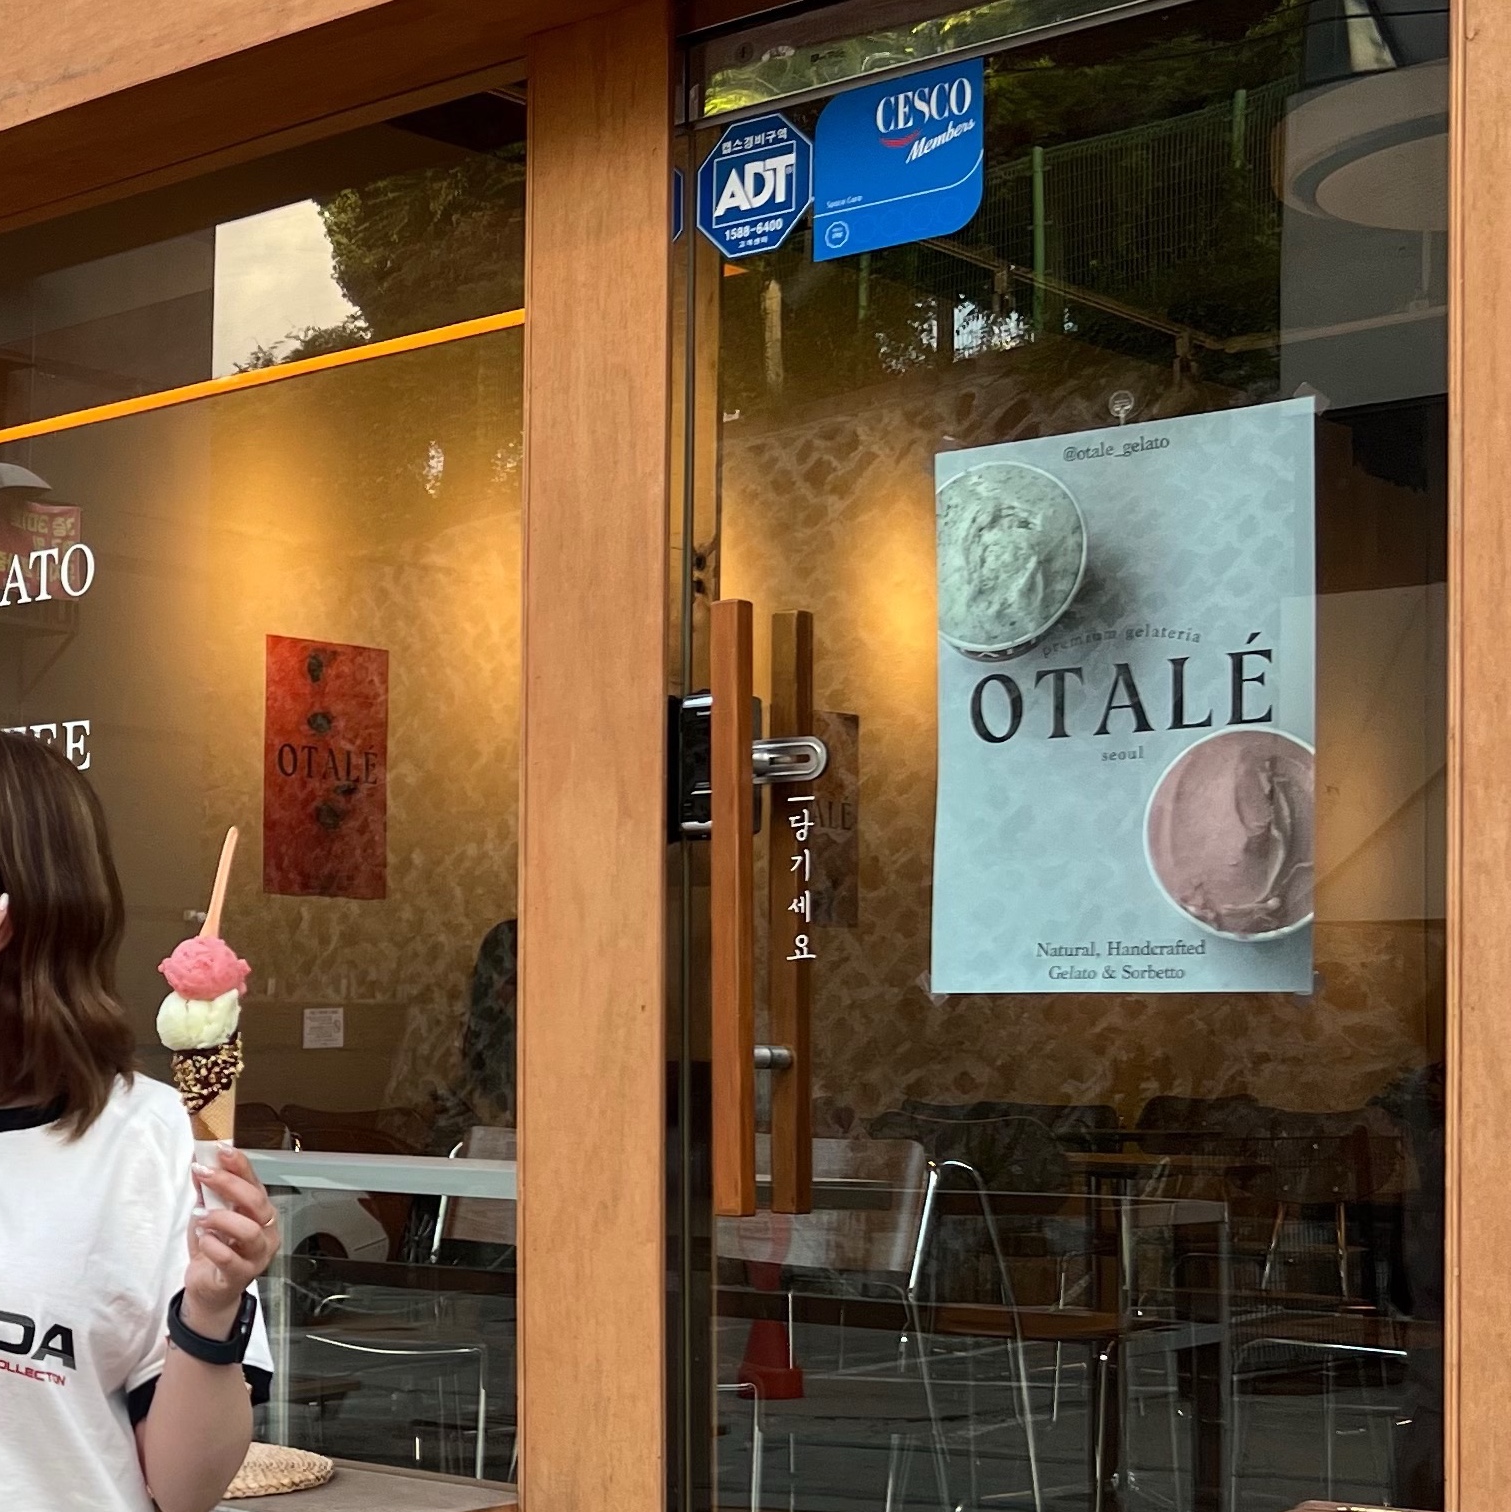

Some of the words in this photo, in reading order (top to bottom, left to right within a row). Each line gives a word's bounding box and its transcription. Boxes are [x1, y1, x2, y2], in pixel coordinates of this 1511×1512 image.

[876, 77, 972, 133] CESCO
[721, 127, 788, 154] 캡스경비구역
[905, 118, 976, 164] Members
[714, 153, 796, 217] ADT
[724, 218, 784, 241] 1588-6400
[1063, 435, 1170, 463] @otale_gelato
[1042, 628, 1118, 658] premium
[1125, 624, 1201, 644] gelateria
[970, 632, 1274, 744] OTALÉ
[277, 743, 378, 785] OTALÉ
[1101, 746, 1144, 762] seoul
[786, 808, 817, 961] 당기세요
[1036, 941, 1100, 959] Natural,
[1107, 939, 1206, 956] Handcrafted
[1048, 965, 1097, 980] Gelato
[1101, 965, 1117, 980] &
[1121, 964, 1186, 980] Sorbetto
